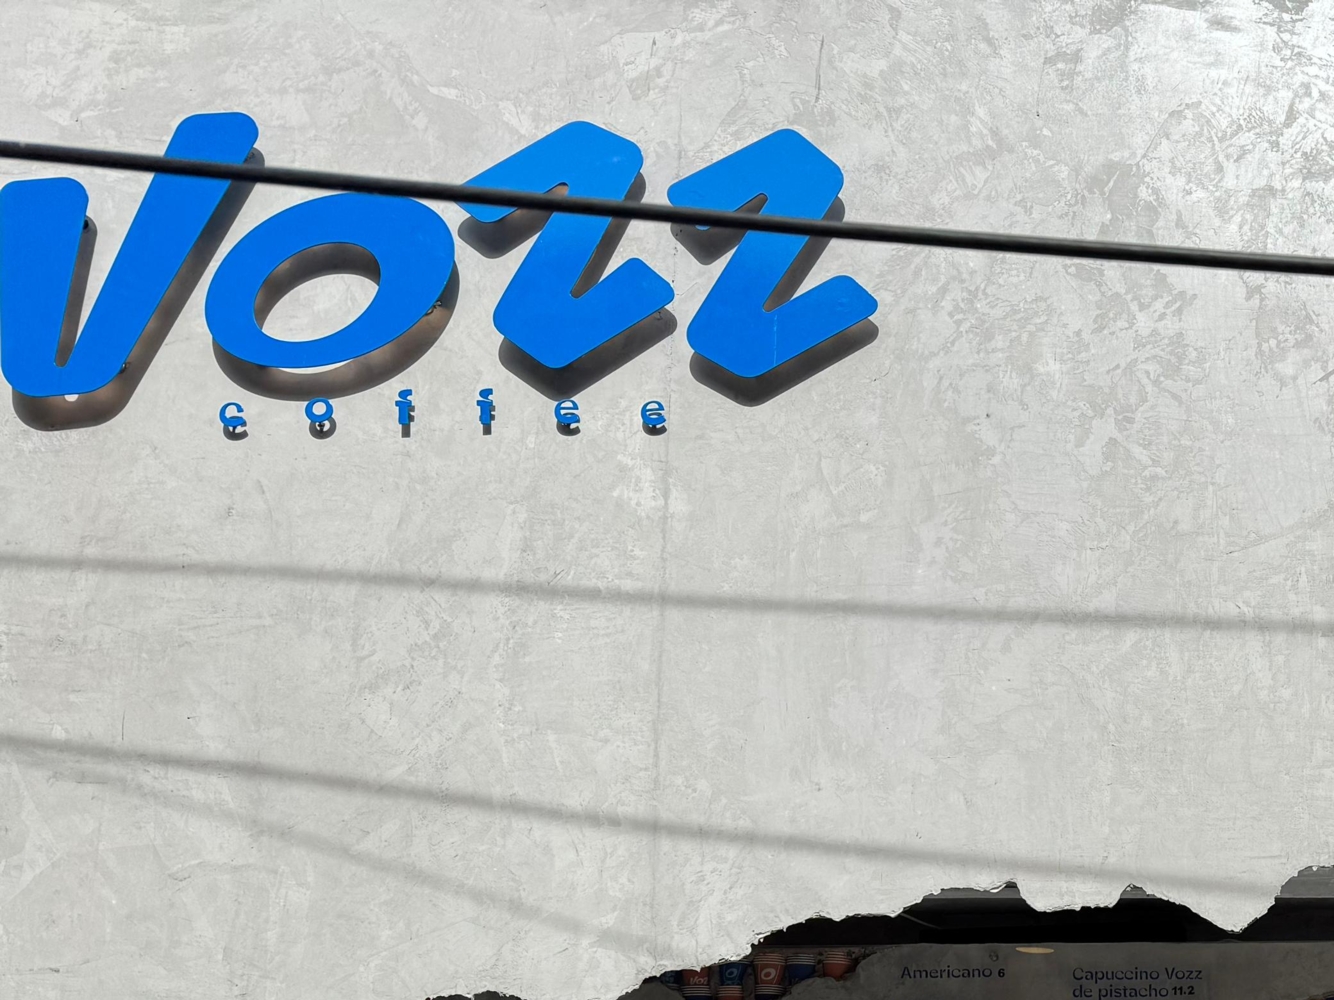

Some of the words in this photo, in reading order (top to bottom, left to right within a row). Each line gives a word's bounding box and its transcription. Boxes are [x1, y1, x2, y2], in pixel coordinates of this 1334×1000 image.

[219, 388, 666, 428] coffee
[900, 966, 993, 979] Americano
[998, 968, 1005, 978] 6
[1073, 967, 1159, 984] Capuccino
[1165, 967, 1203, 980] Vozz
[1073, 985, 1093, 998] de
[1172, 986, 1195, 996] 11.2
